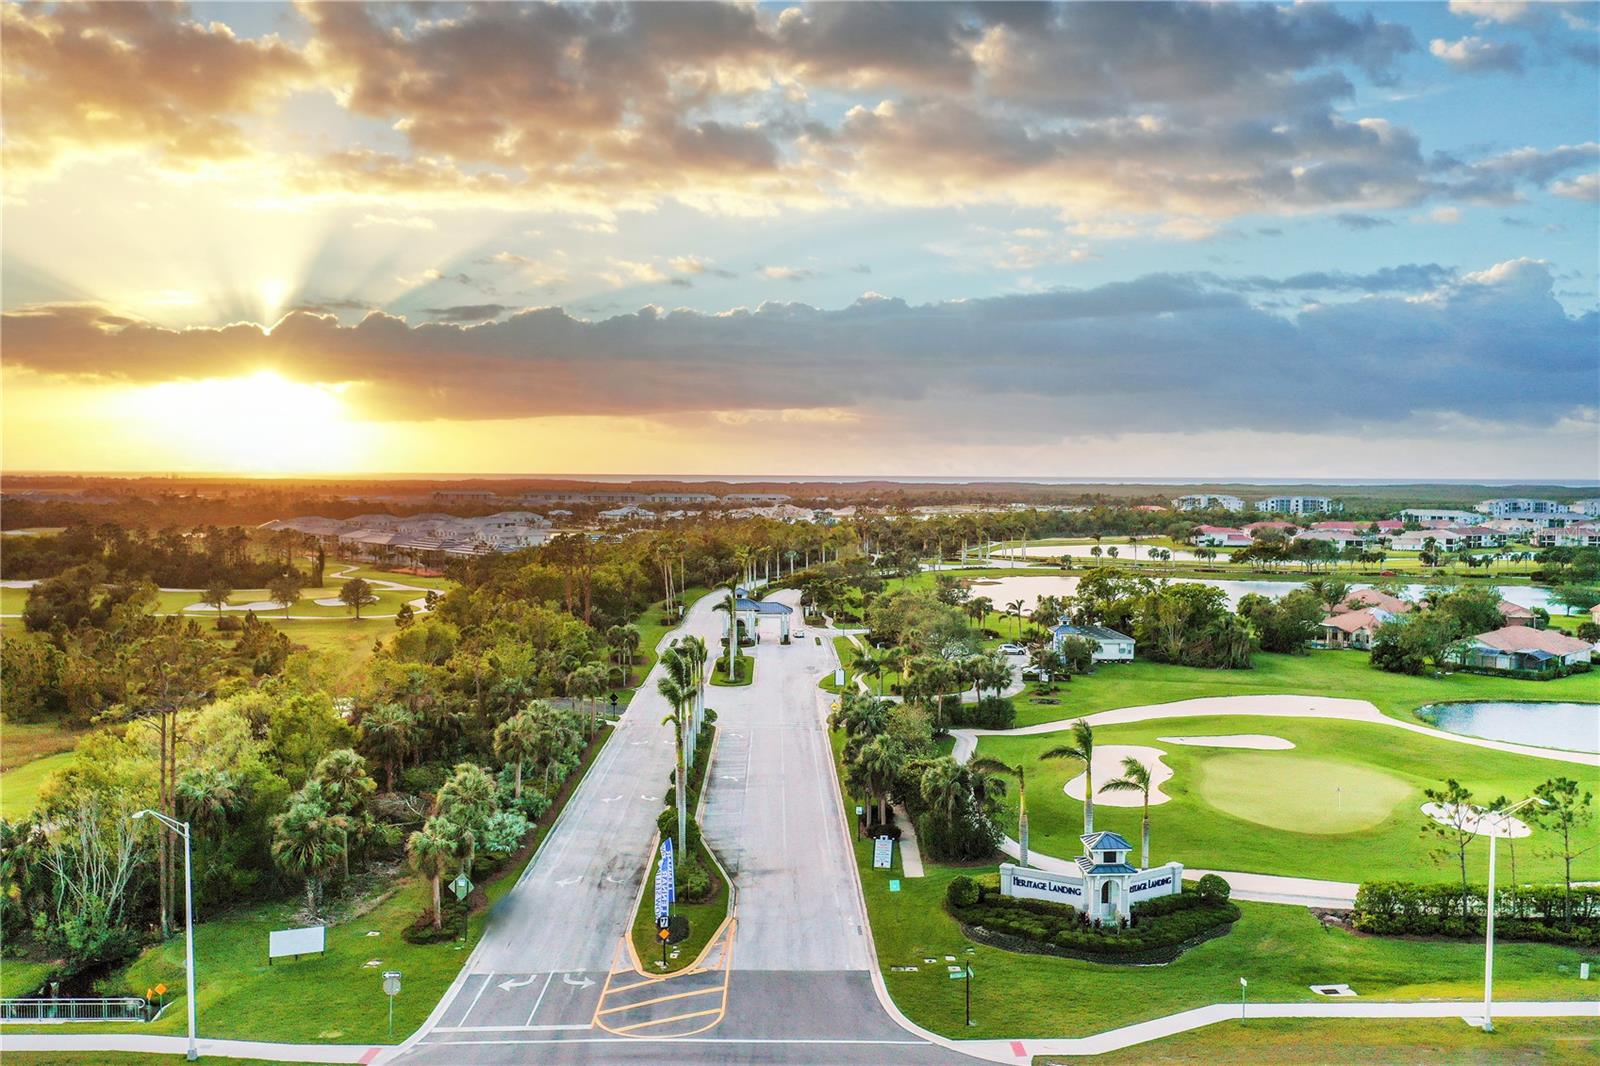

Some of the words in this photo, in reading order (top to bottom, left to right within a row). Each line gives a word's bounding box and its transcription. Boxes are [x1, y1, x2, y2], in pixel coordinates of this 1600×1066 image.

[1013, 876, 1047, 891] HERITAGE
[1048, 881, 1082, 896] LANDING
[1148, 876, 1172, 889] LANDING
